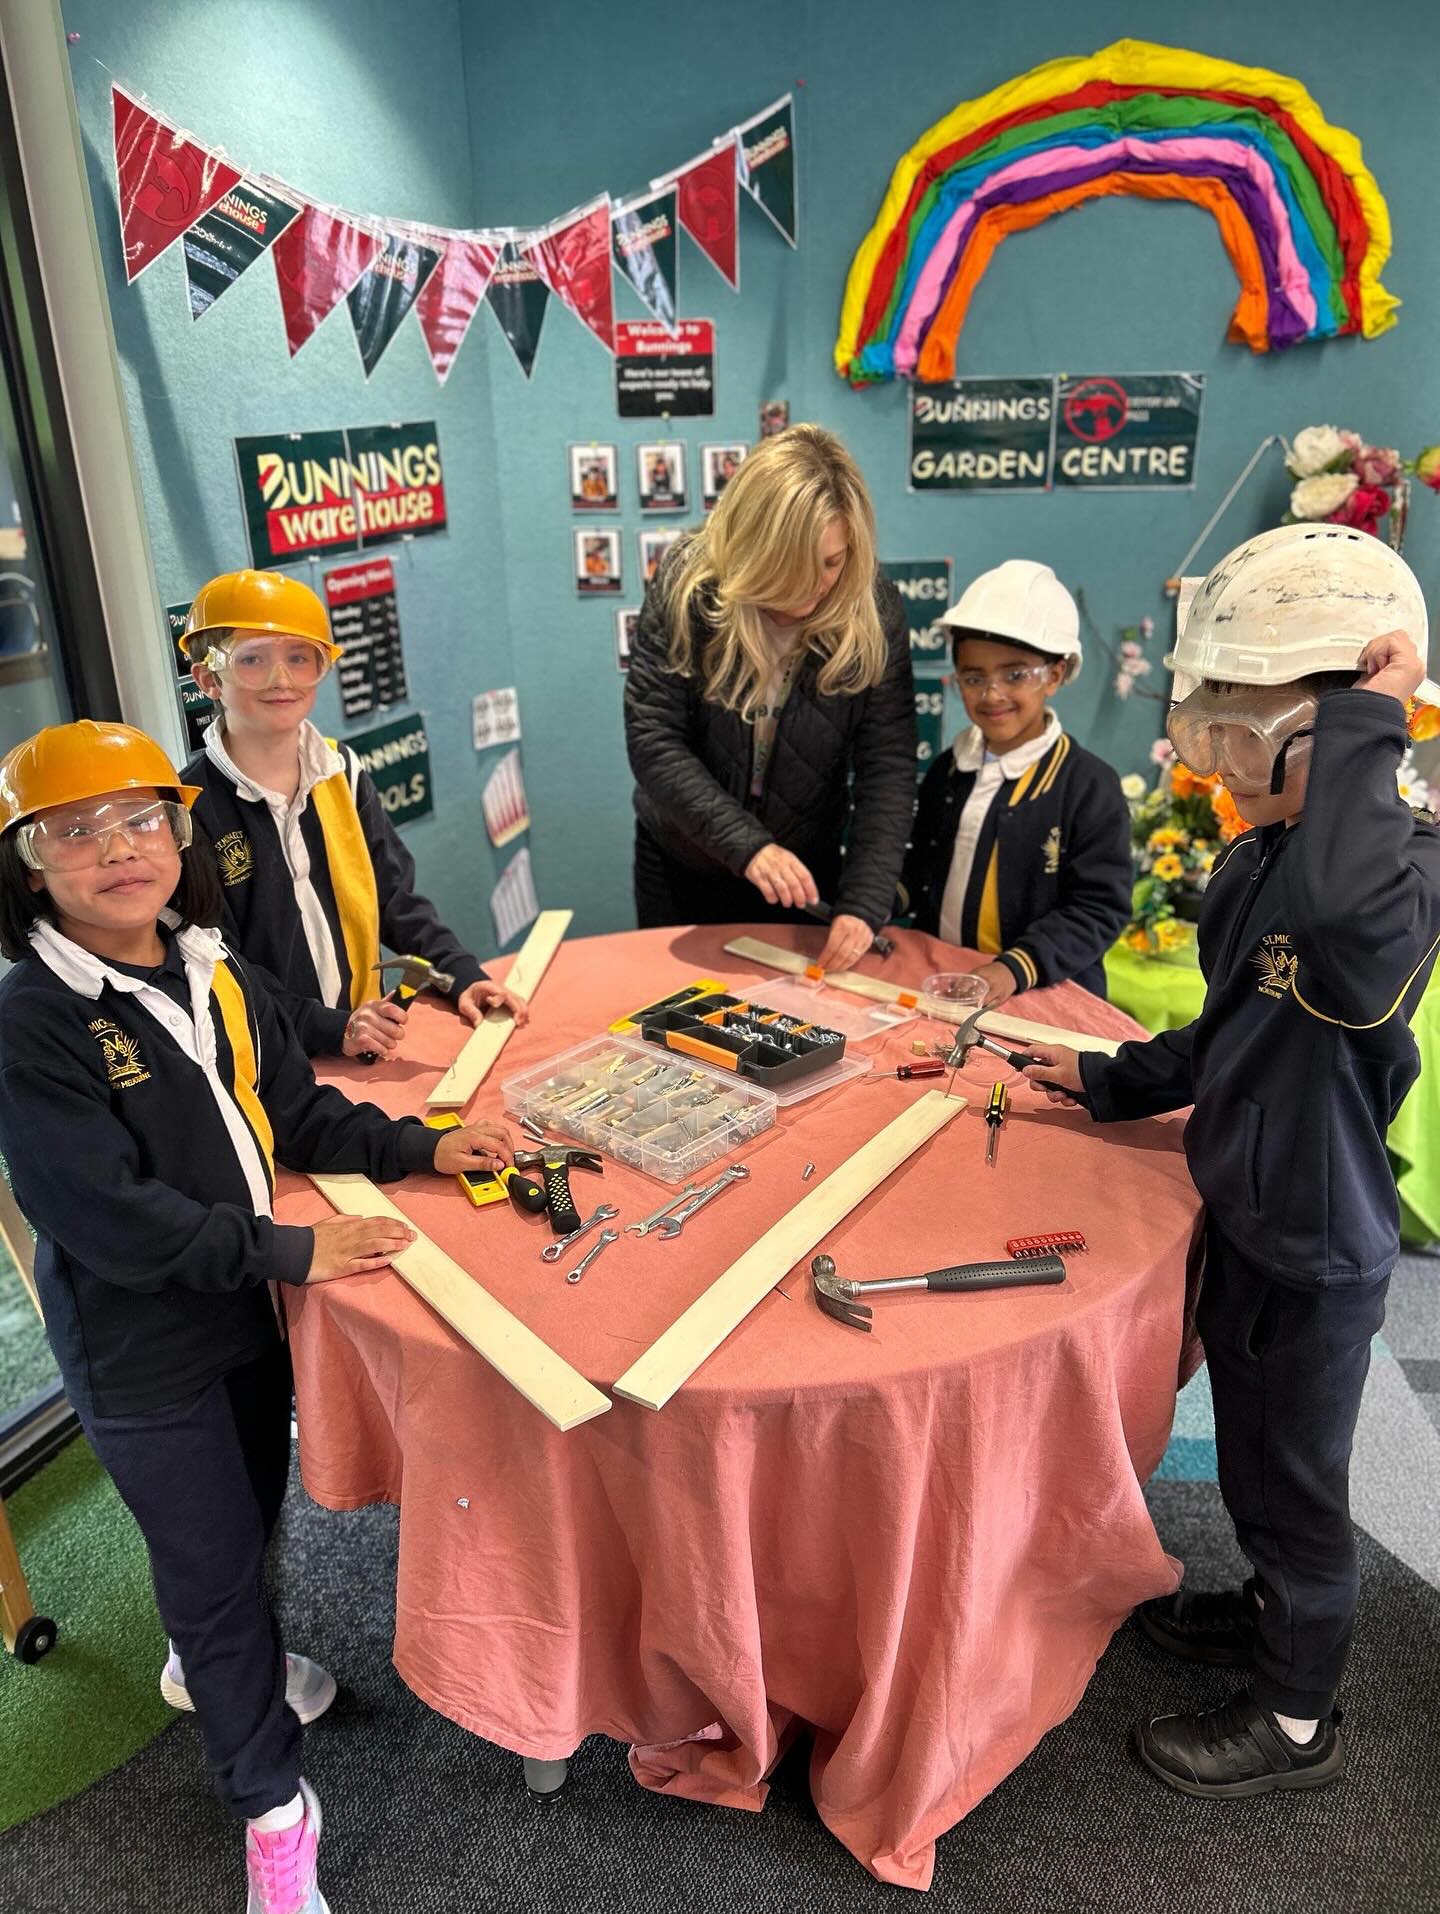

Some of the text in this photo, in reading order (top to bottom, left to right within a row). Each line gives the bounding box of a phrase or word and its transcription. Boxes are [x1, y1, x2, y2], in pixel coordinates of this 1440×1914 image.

[636, 340, 693, 355] Bunnings
[914, 396, 1050, 424] BUNNINGS
[257, 443, 442, 510] BUNNINGS
[911, 445, 1189, 479] GARDEN CENTRE
